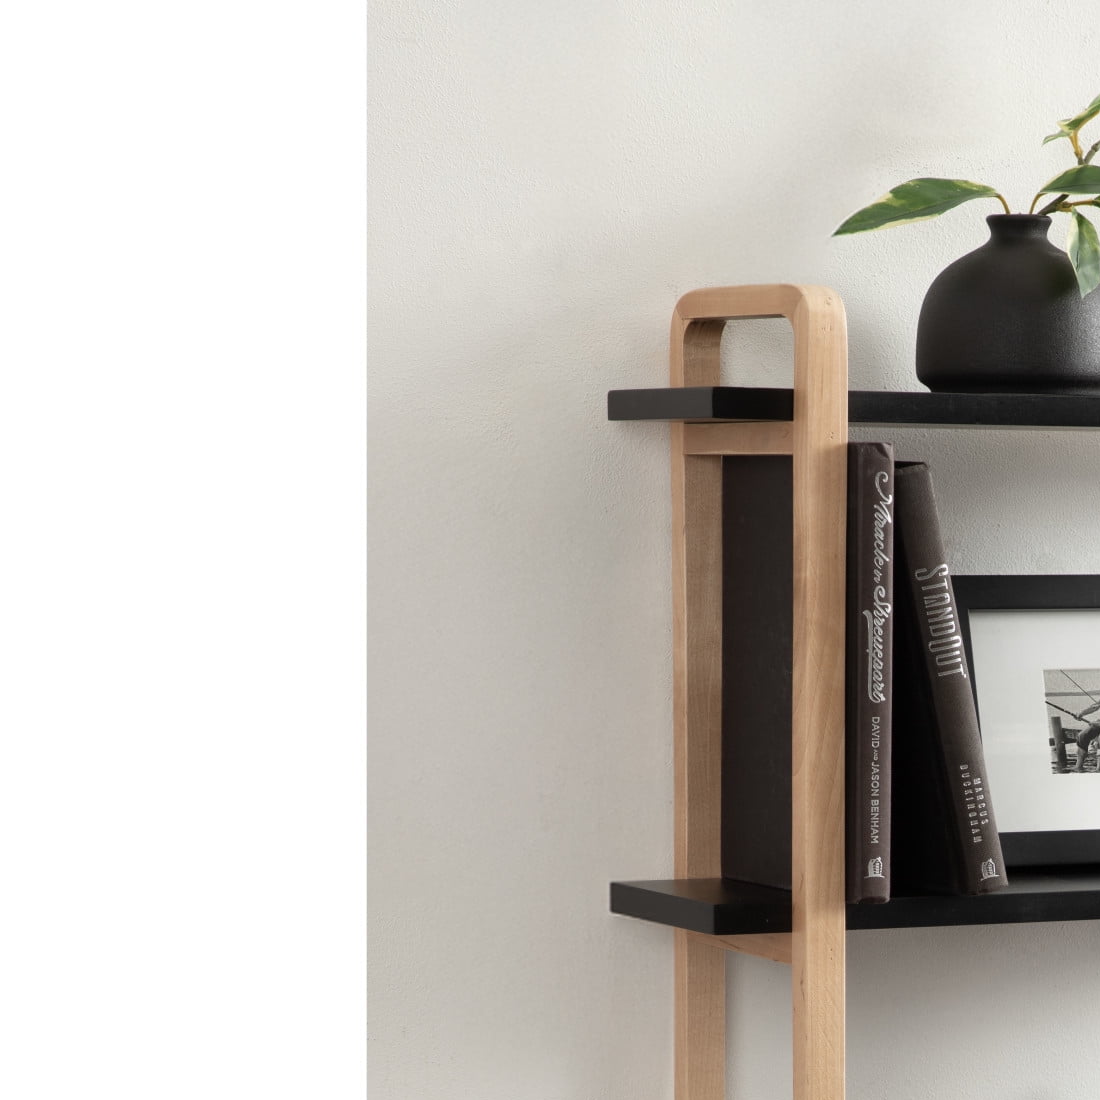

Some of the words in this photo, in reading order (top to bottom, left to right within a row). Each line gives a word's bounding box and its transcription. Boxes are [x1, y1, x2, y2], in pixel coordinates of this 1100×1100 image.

[874, 471, 892, 569] Miracle
[873, 568, 882, 584] in
[862, 585, 892, 703] Shreveport
[871, 716, 881, 749] DAVID
[871, 762, 880, 797] JASON
[973, 777, 989, 825] MARCUS
[870, 799, 880, 844] BENHAM
[959, 764, 983, 844] BUCKINGHAM
